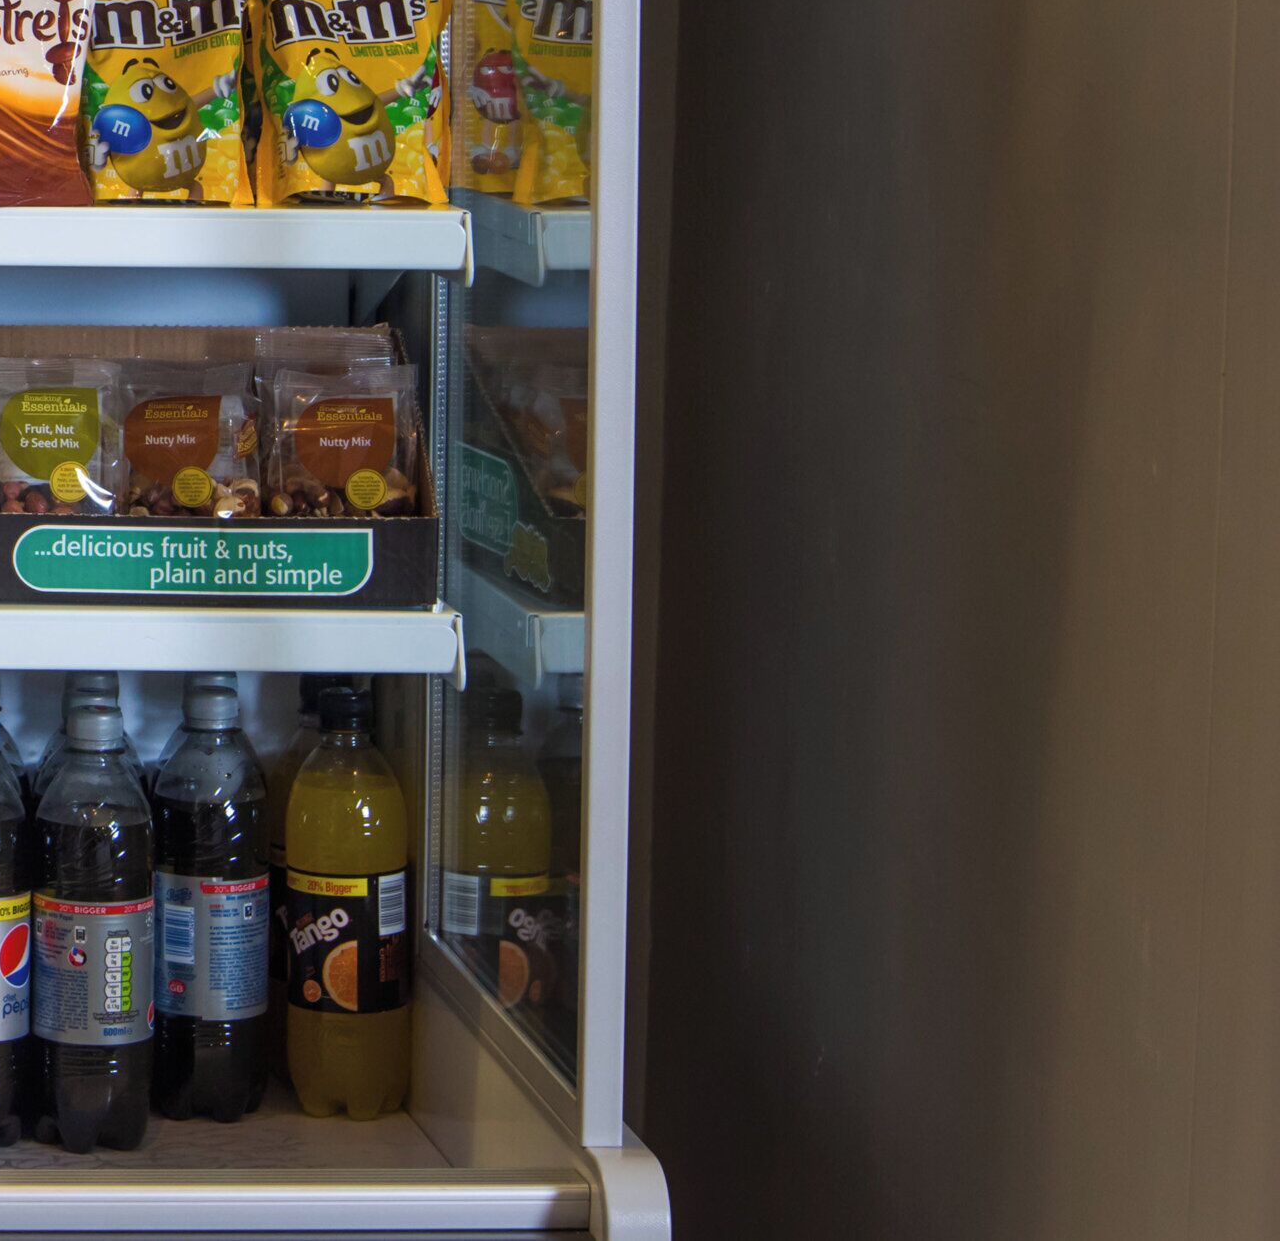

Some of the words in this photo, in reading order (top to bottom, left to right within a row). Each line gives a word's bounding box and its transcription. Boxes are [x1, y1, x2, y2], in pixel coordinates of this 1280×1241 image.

[25, 424, 52, 437] Fruit,
[55, 424, 74, 435] Nut
[31, 437, 57, 448] Seed
[145, 435, 174, 448] Nutty
[176, 435, 196, 445] Mix
[35, 535, 154, 558] ...delicious
[161, 536, 207, 559] fruit
[215, 540, 230, 559] &
[238, 540, 293, 563] nuts,
[150, 562, 207, 588] plain
[214, 564, 257, 585] and
[265, 564, 343, 591] simple
[290, 908, 349, 955] Tango
